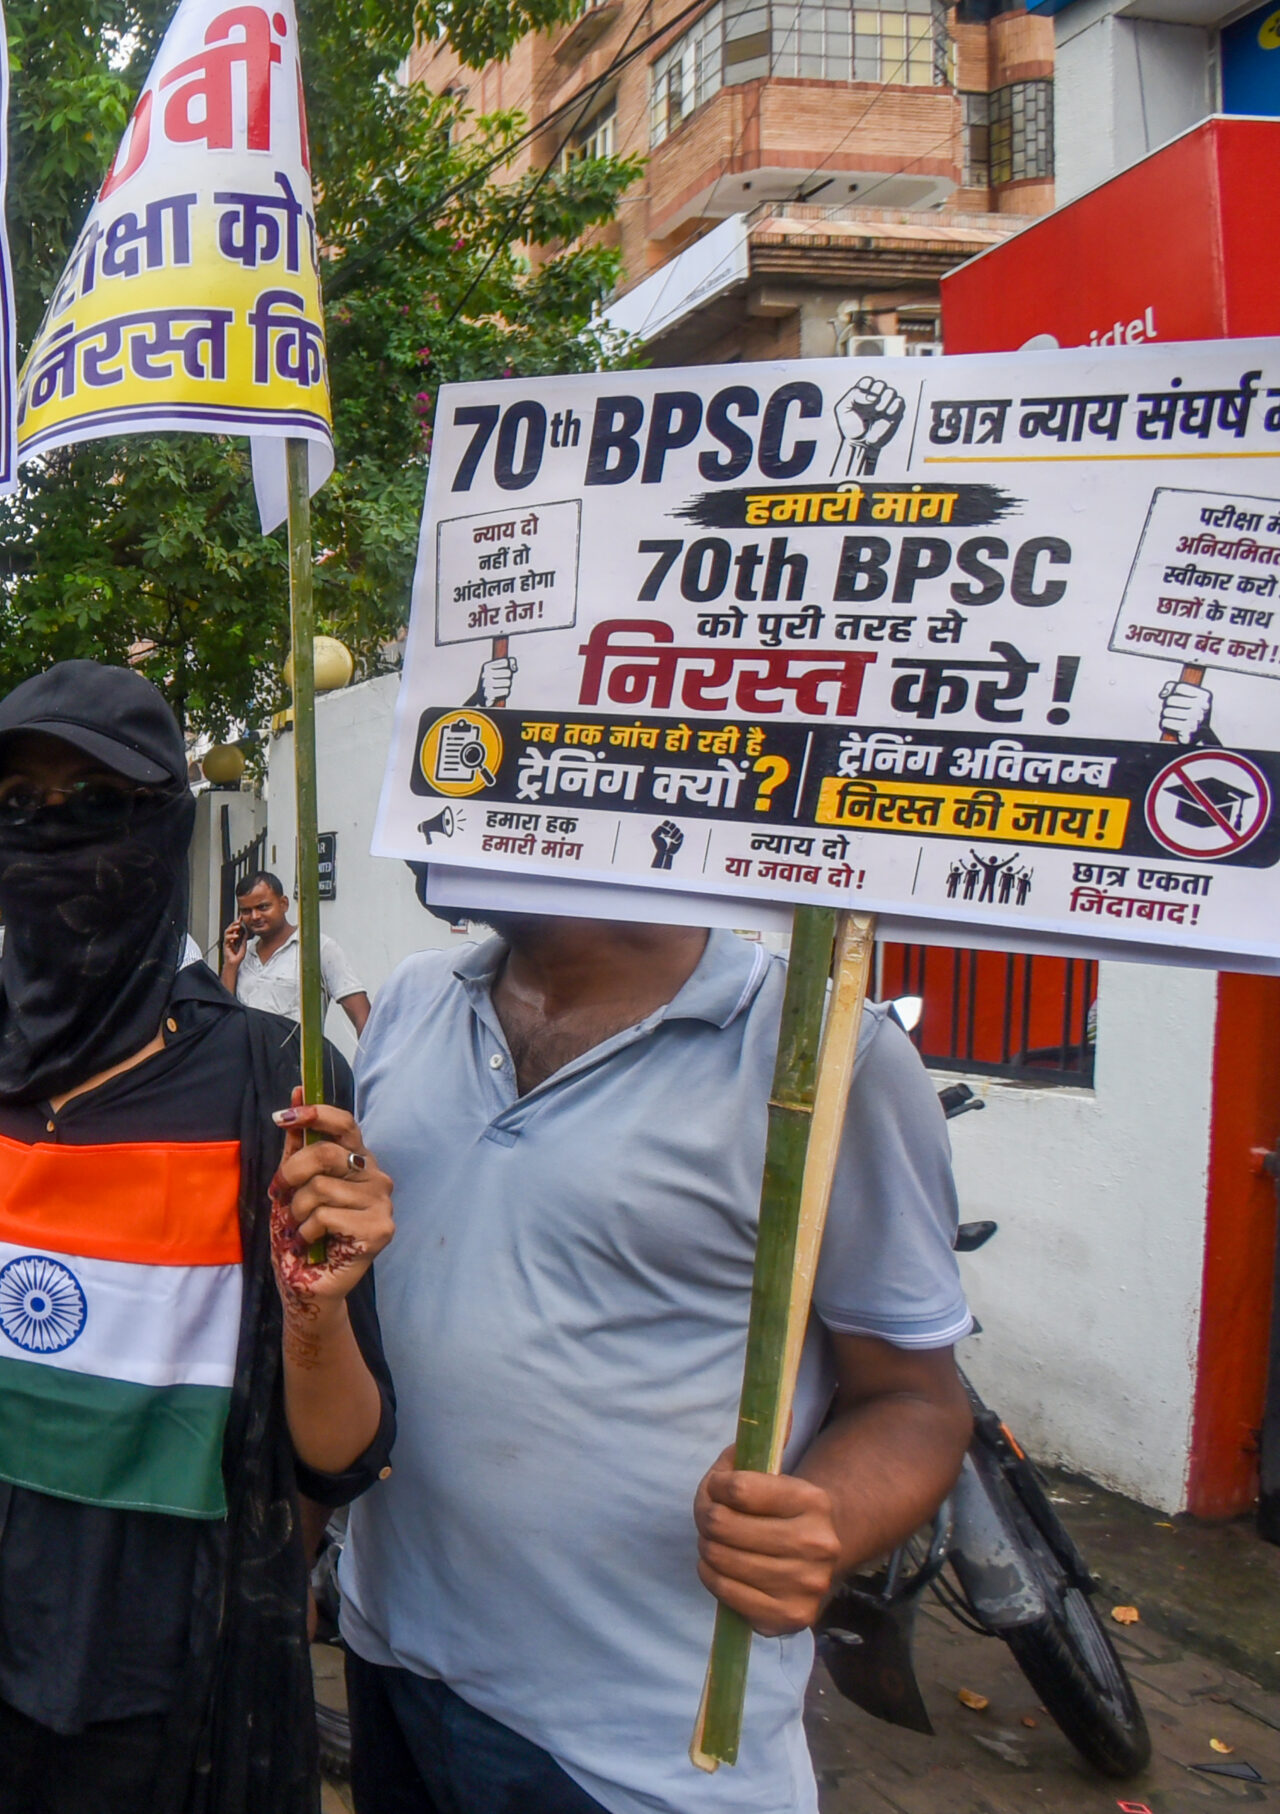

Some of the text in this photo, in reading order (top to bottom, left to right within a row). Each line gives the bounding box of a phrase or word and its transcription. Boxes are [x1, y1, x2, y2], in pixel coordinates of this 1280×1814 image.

[99, 4, 286, 202] वीं
[53, 193, 197, 319] रीक्षा
[214, 171, 304, 272] को
[248, 290, 323, 388] कि
[1078, 307, 1157, 349] irtel
[929, 397, 1013, 446] छात्र
[1020, 394, 1128, 444] न्याय
[1136, 370, 1262, 441] संघर्ष
[451, 381, 823, 493] 70th BPSC
[745, 479, 958, 526] हमारी मांग
[1199, 504, 1265, 533] परीक्षा
[473, 513, 539, 546] न्याय दो
[478, 545, 532, 572] नहीं तो
[1176, 532, 1280, 567] अनियमित
[453, 570, 556, 604] आंदोलन होगा
[637, 535, 1072, 608] 70th BPSC
[1163, 562, 1280, 599] स्वीकार करो
[467, 604, 502, 630] और
[697, 605, 747, 641] को
[834, 613, 917, 643] तरह
[927, 609, 967, 643] से
[1156, 596, 1275, 630] छात्रों के साथ
[1125, 623, 1192, 650] अन्याय
[1194, 630, 1225, 655] बंद
[578, 618, 878, 717] निरस्त
[520, 721, 767, 757] जब तक जांच हो रही है
[516, 746, 645, 801] ट्रेनिंग
[837, 732, 1118, 789] ट्रेनिंग अविलम्ब
[485, 810, 579, 835] हमारा हक
[835, 781, 946, 827] निरस्त
[953, 789, 1005, 831] की
[481, 832, 584, 861] हमारी मांग
[751, 832, 851, 861] न्याय दो
[725, 857, 753, 878] या
[758, 860, 823, 885] जवाब
[1072, 861, 1214, 897] छात्र एकता
